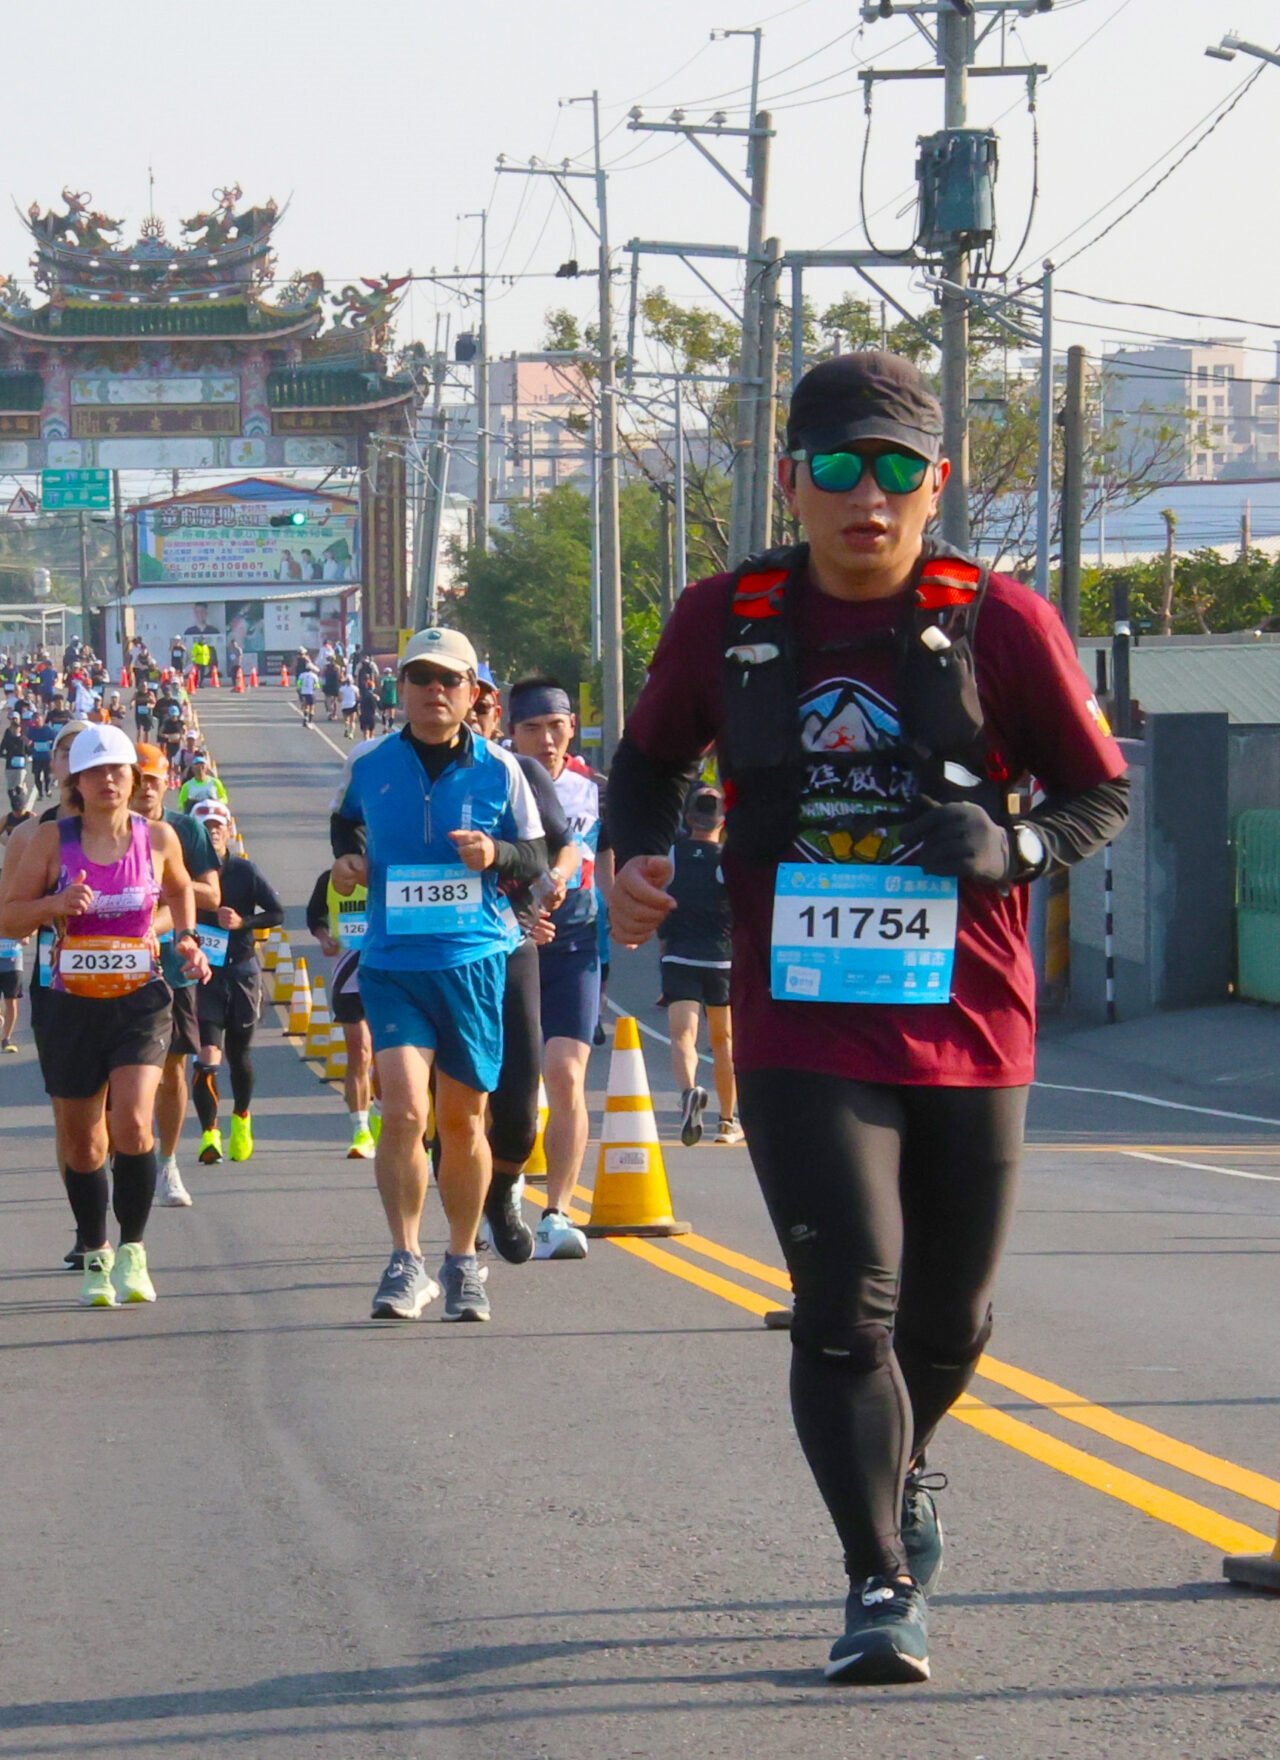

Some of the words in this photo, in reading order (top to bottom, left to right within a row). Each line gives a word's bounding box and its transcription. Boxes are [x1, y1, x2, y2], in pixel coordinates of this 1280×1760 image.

[401, 883, 468, 903] 11383
[799, 905, 930, 941] 11754
[71, 954, 137, 970] 20323
